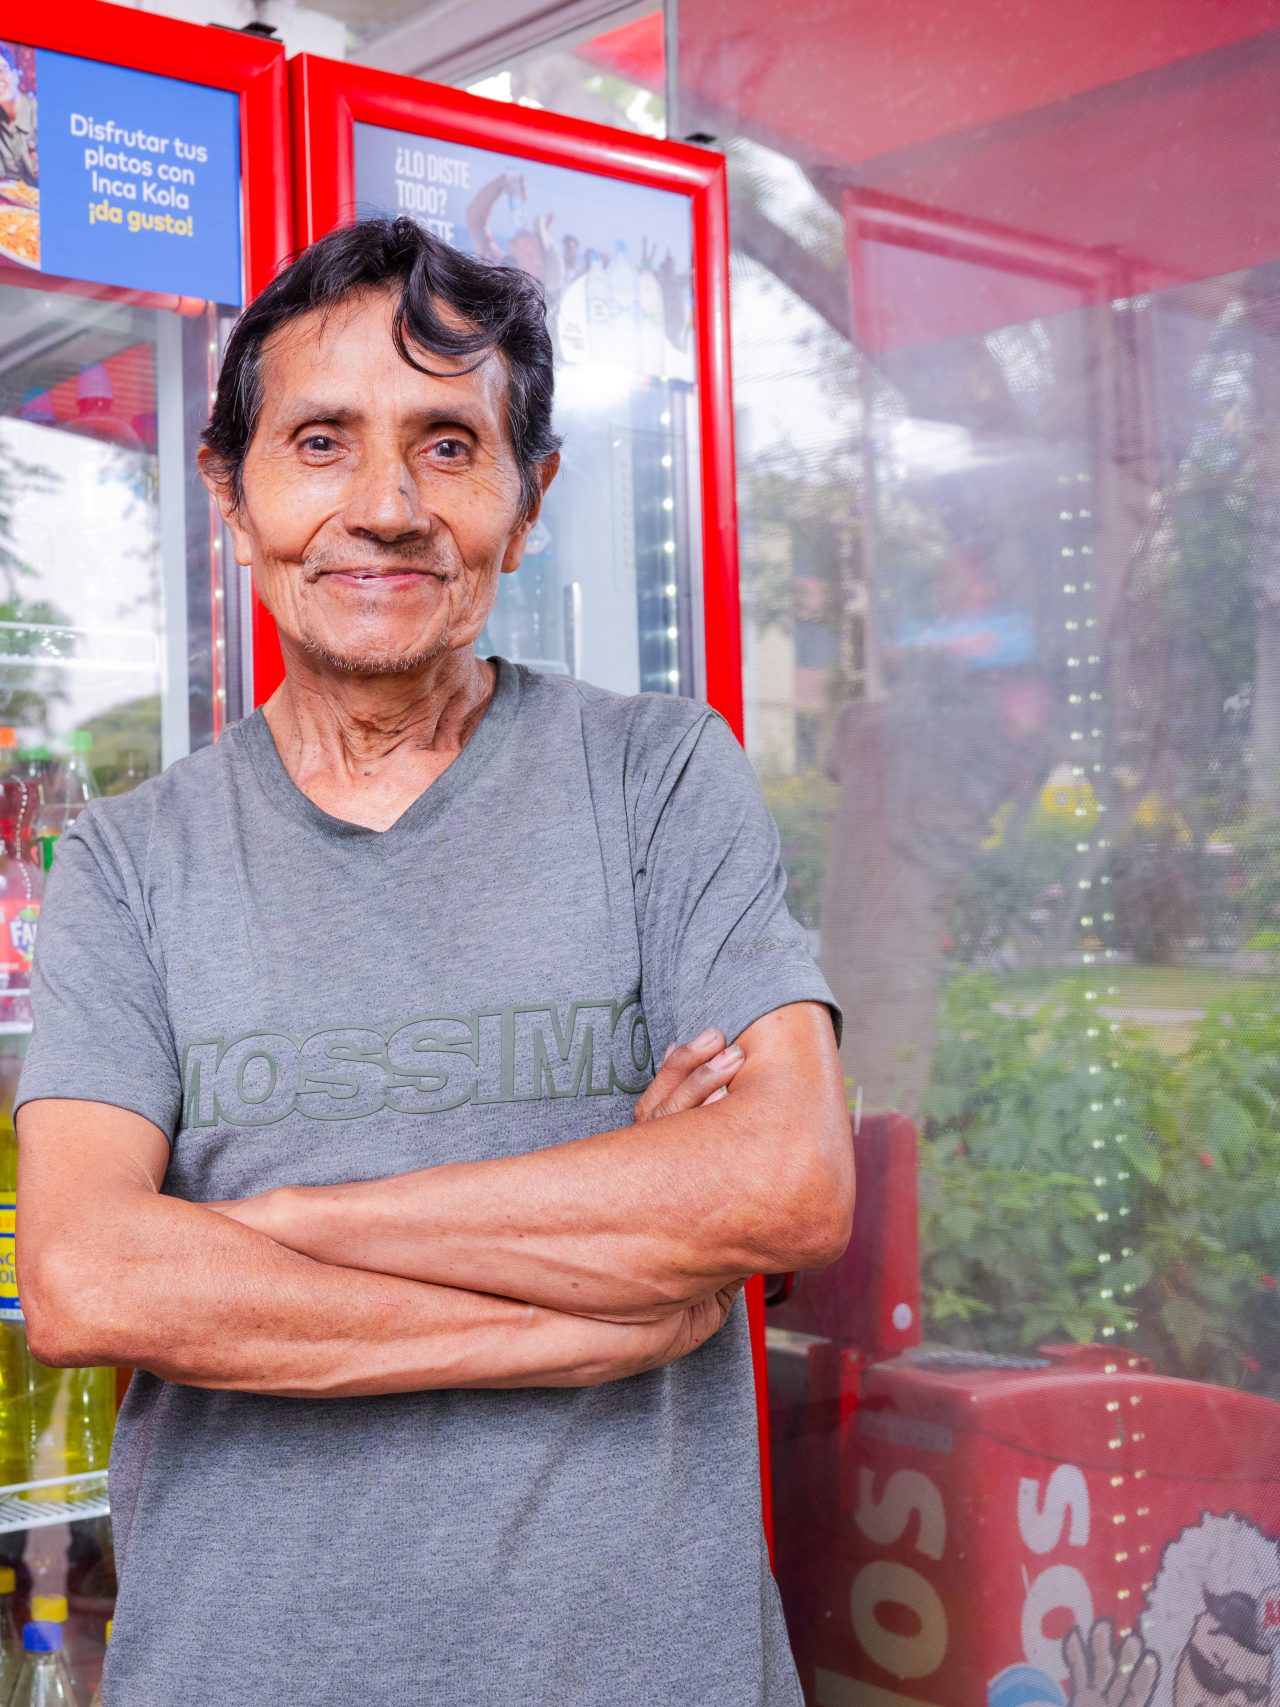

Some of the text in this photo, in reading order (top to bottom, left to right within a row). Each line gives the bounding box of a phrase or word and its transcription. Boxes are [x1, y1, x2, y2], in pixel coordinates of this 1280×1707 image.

[70, 112, 208, 163] Disfrutar tus
[84, 145, 195, 185] platos con
[395, 147, 471, 190] ¿LO DISTE
[92, 170, 190, 210] Inca Kola
[395, 179, 448, 216] TODO?
[88, 199, 194, 238] ¡da gusto!
